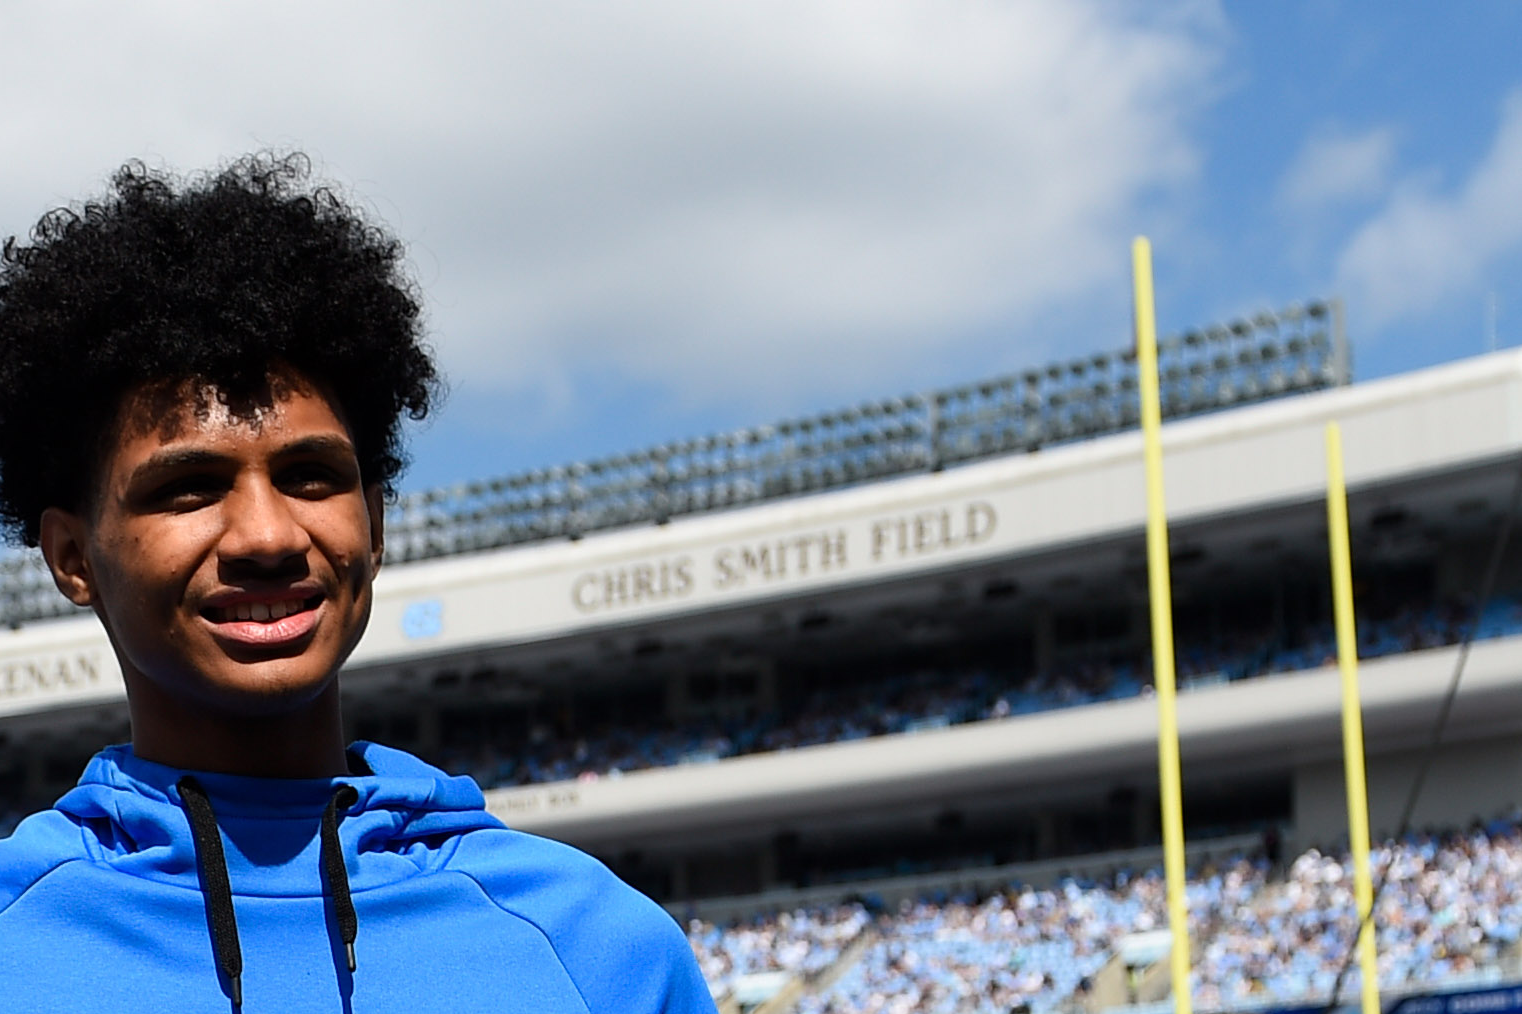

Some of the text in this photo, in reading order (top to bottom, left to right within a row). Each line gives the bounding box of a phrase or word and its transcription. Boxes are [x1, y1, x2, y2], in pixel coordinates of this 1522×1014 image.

[571, 556, 695, 614] CHRIS
[711, 528, 849, 590] SMITH
[869, 501, 998, 563] FIELD
